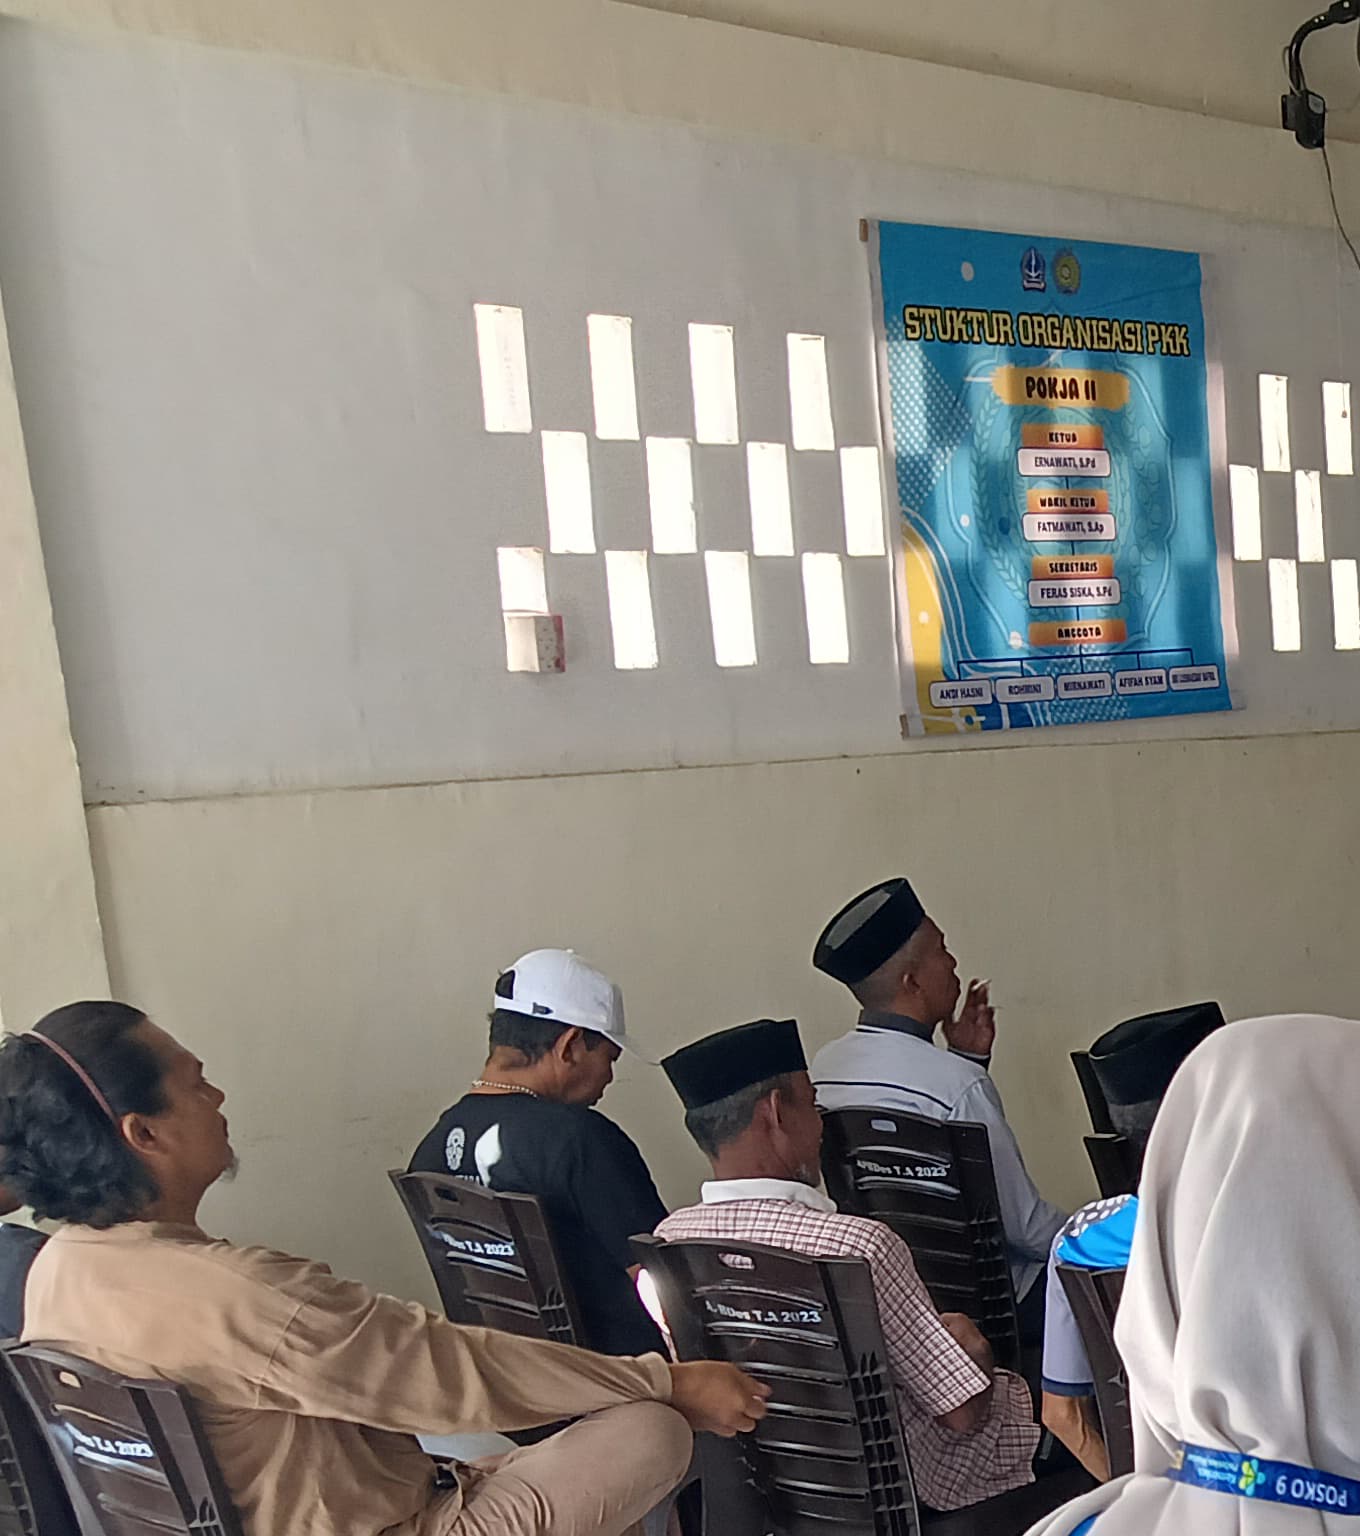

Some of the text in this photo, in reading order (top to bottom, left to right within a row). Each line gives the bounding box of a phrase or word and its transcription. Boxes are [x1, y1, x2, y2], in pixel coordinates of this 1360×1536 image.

[904, 305, 1190, 356] STUKTUR ORGANISASI PKK
[1025, 376, 1079, 401] POKJA
[1048, 431, 1077, 443] KETUA
[915, 1166, 947, 1177] 2023
[781, 1311, 822, 1323] 2023
[1275, 1476, 1348, 1508] POSKO 9
